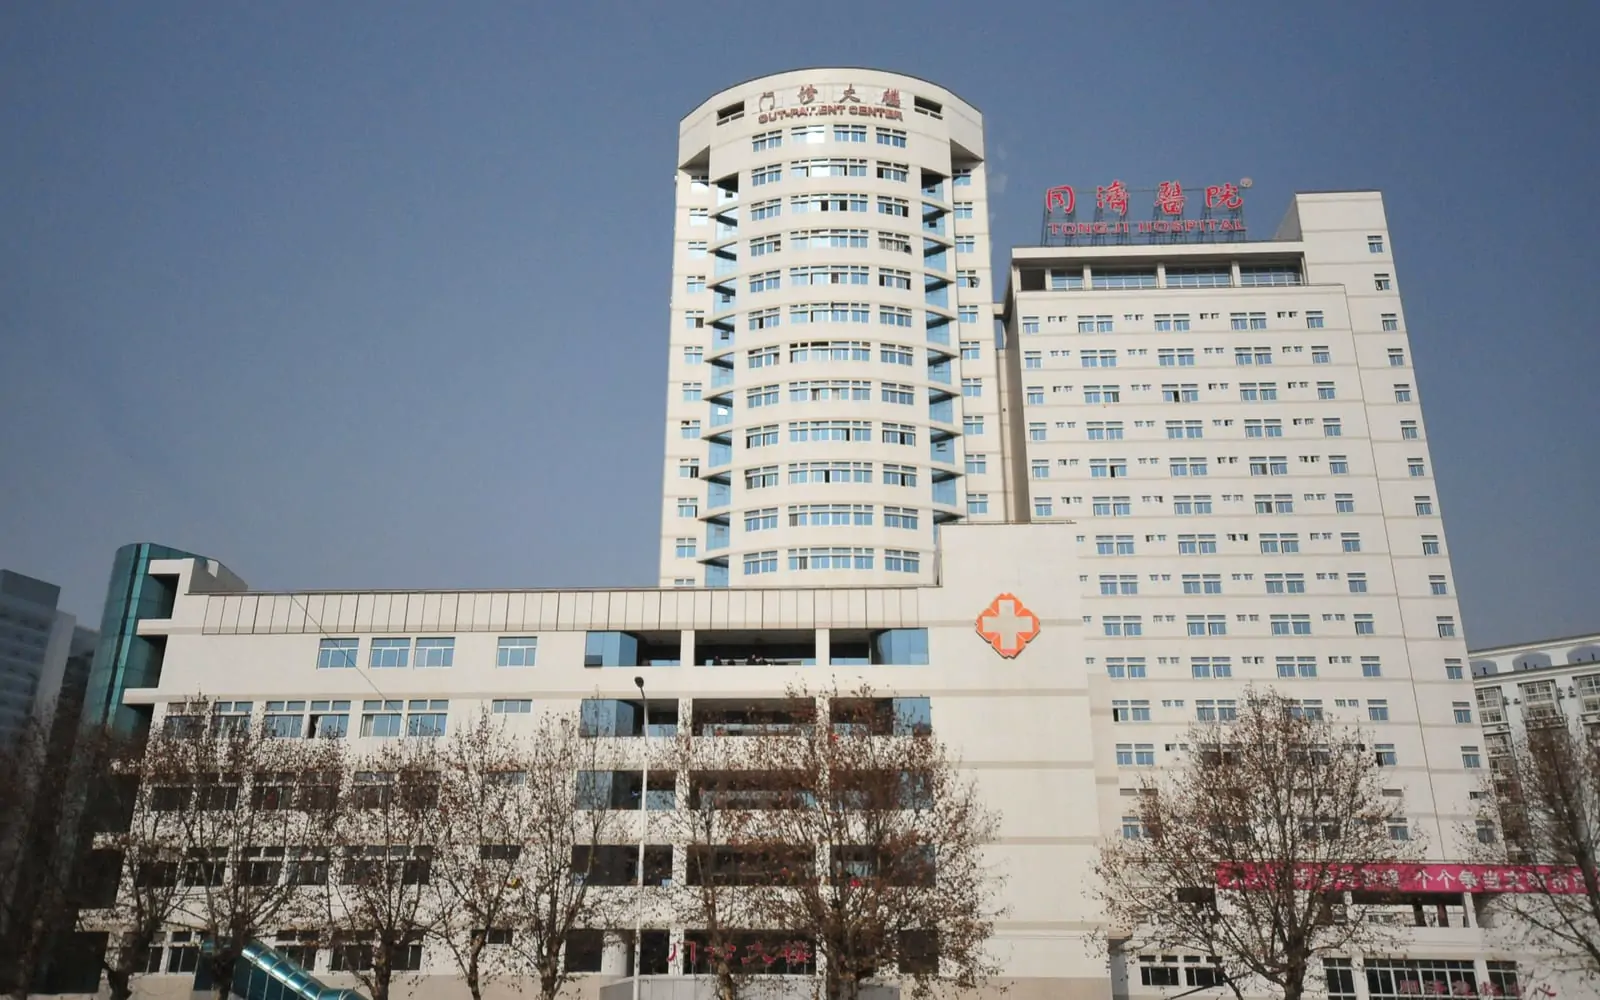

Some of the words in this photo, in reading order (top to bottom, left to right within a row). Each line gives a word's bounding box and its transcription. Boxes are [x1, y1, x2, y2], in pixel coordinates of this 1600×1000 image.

[849, 106, 904, 121] CENTER
[1050, 221, 1129, 235] TONGJI
[1138, 218, 1248, 233] HOSPITAL
